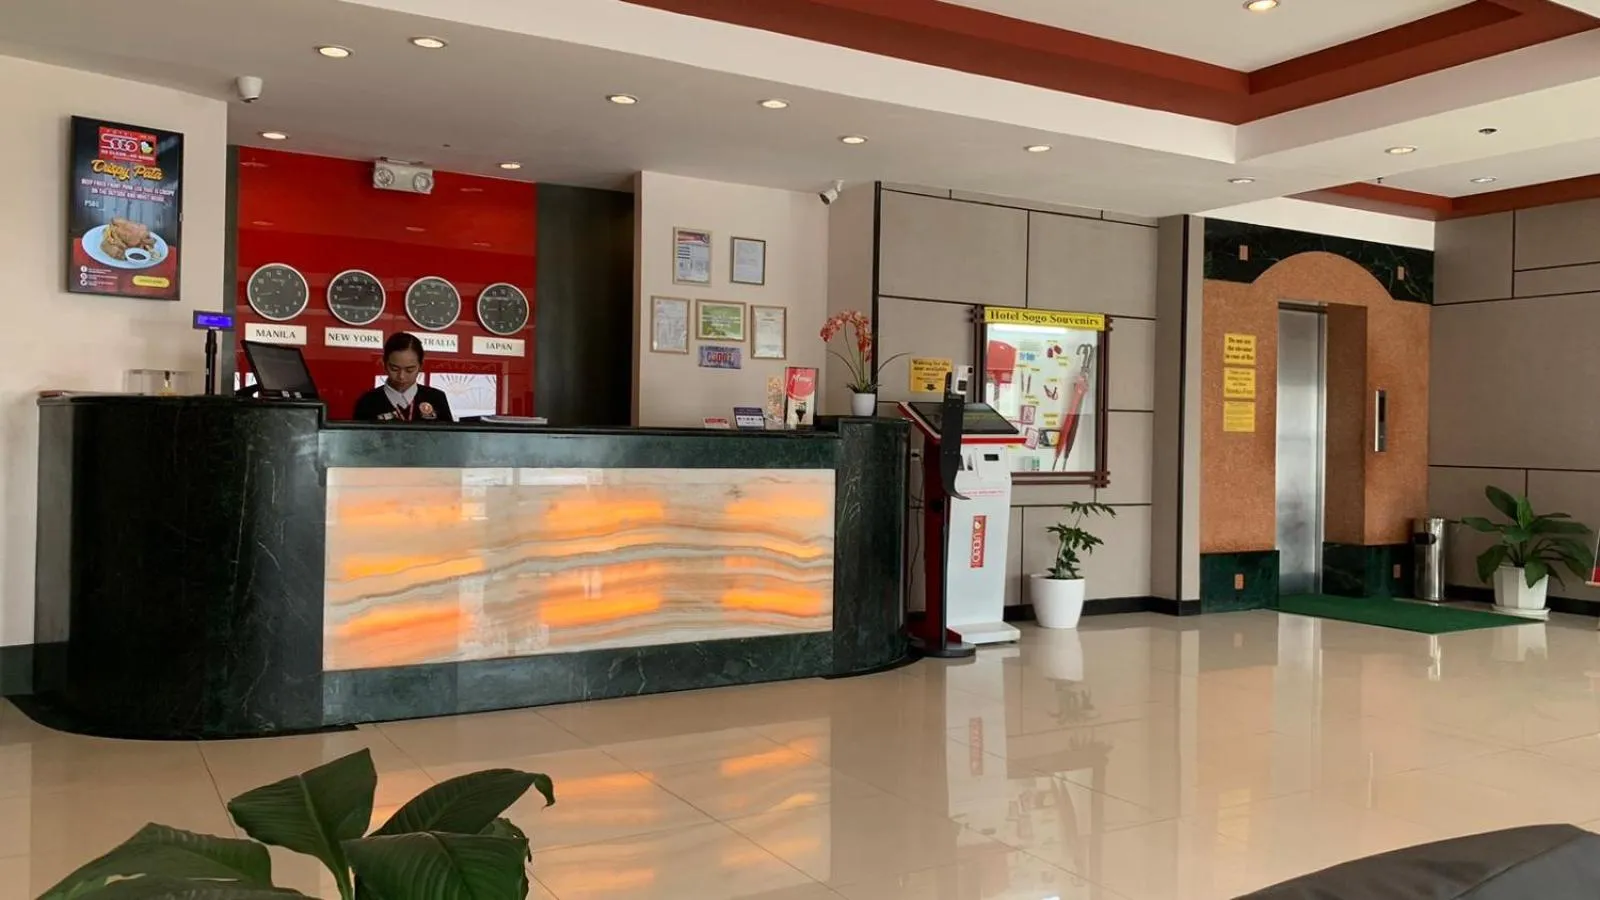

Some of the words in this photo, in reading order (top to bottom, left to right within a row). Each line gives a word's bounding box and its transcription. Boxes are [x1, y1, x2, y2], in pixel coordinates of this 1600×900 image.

[91, 159, 130, 181] Crispy
[133, 164, 163, 181] Pata
[990, 310, 1019, 320] Hotel
[1022, 311, 1047, 323] Sogo
[1050, 314, 1099, 325] Souvenirs
[255, 329, 296, 338] MANILA
[328, 332, 351, 341] NEW
[353, 335, 380, 343] YORK
[423, 338, 456, 347] TRALIA
[485, 342, 513, 351] JAPAN
